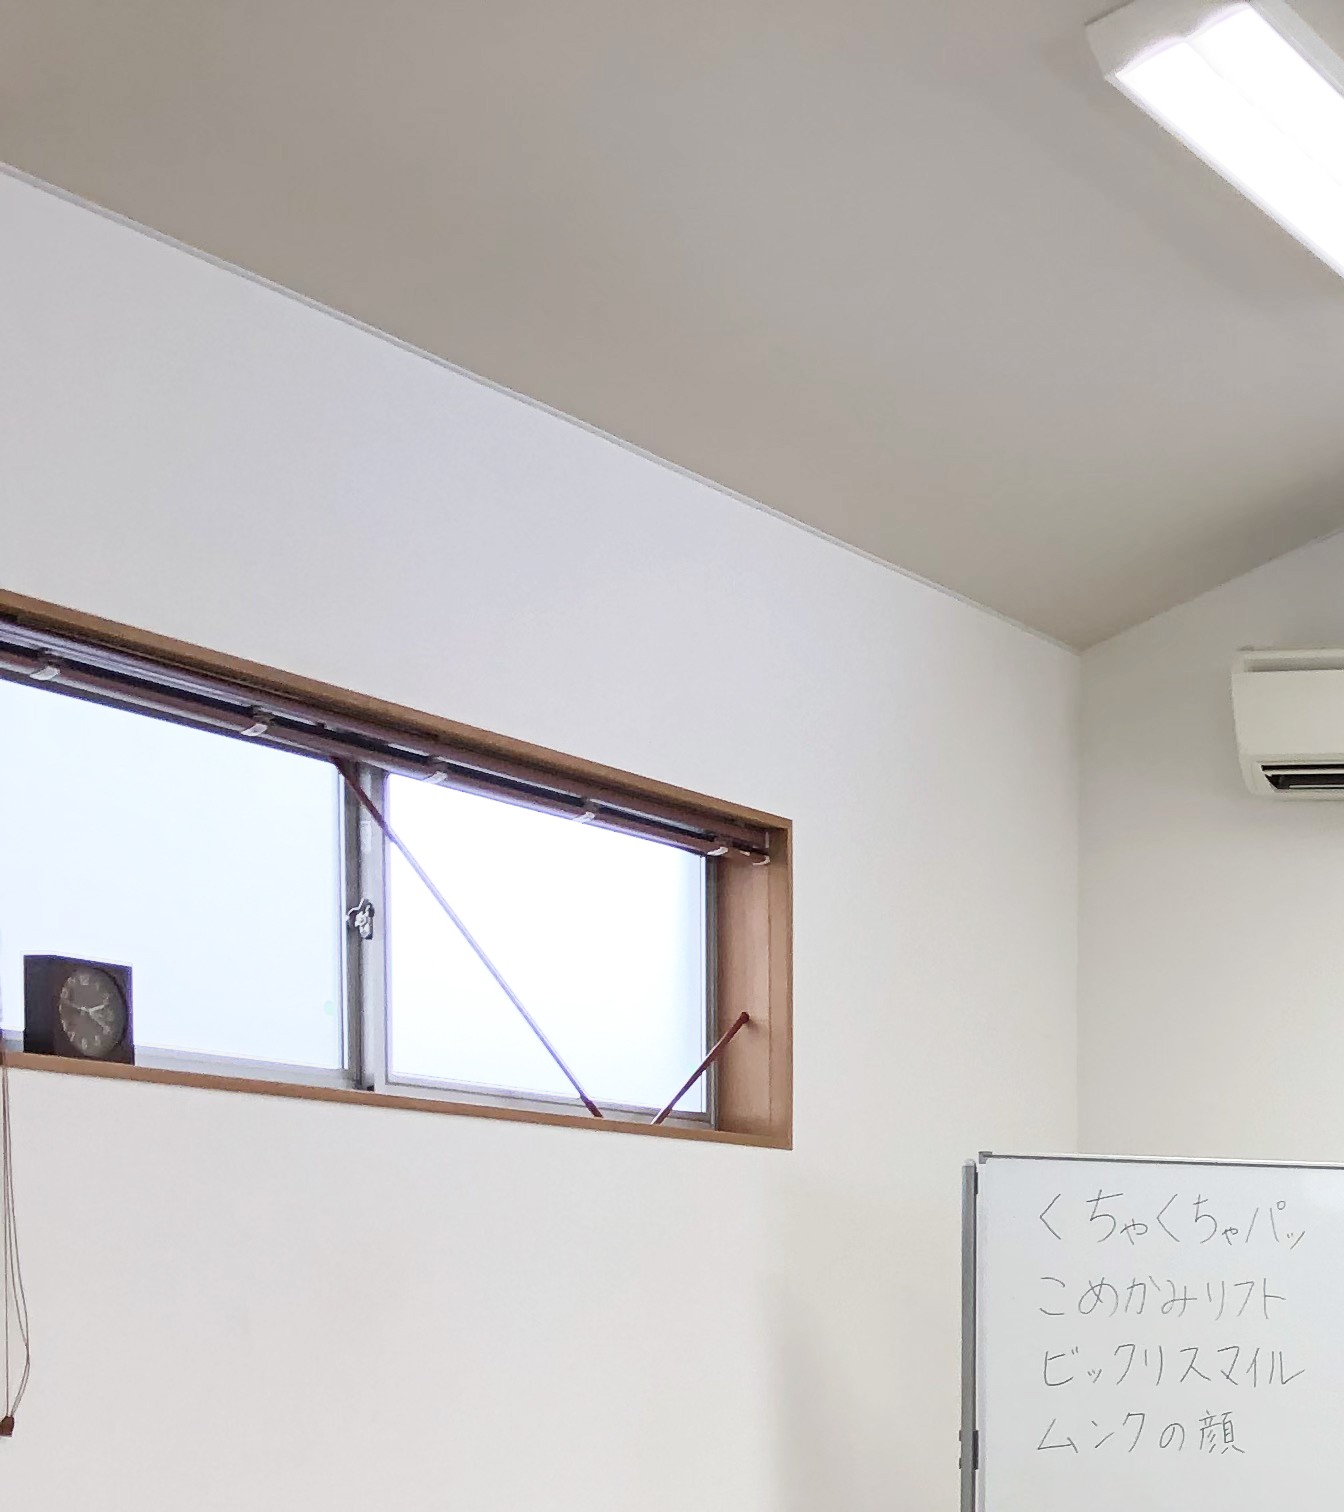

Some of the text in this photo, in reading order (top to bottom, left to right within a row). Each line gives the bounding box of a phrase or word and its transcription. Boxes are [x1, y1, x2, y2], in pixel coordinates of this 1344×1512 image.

[1039, 1188, 1306, 1250] くちゃくちゃパッ
[1039, 1275, 1287, 1321] こめかみリフト
[1043, 1343, 1306, 1388] ビックリスマイル
[1037, 1409, 1246, 1455] ムンクの顔
